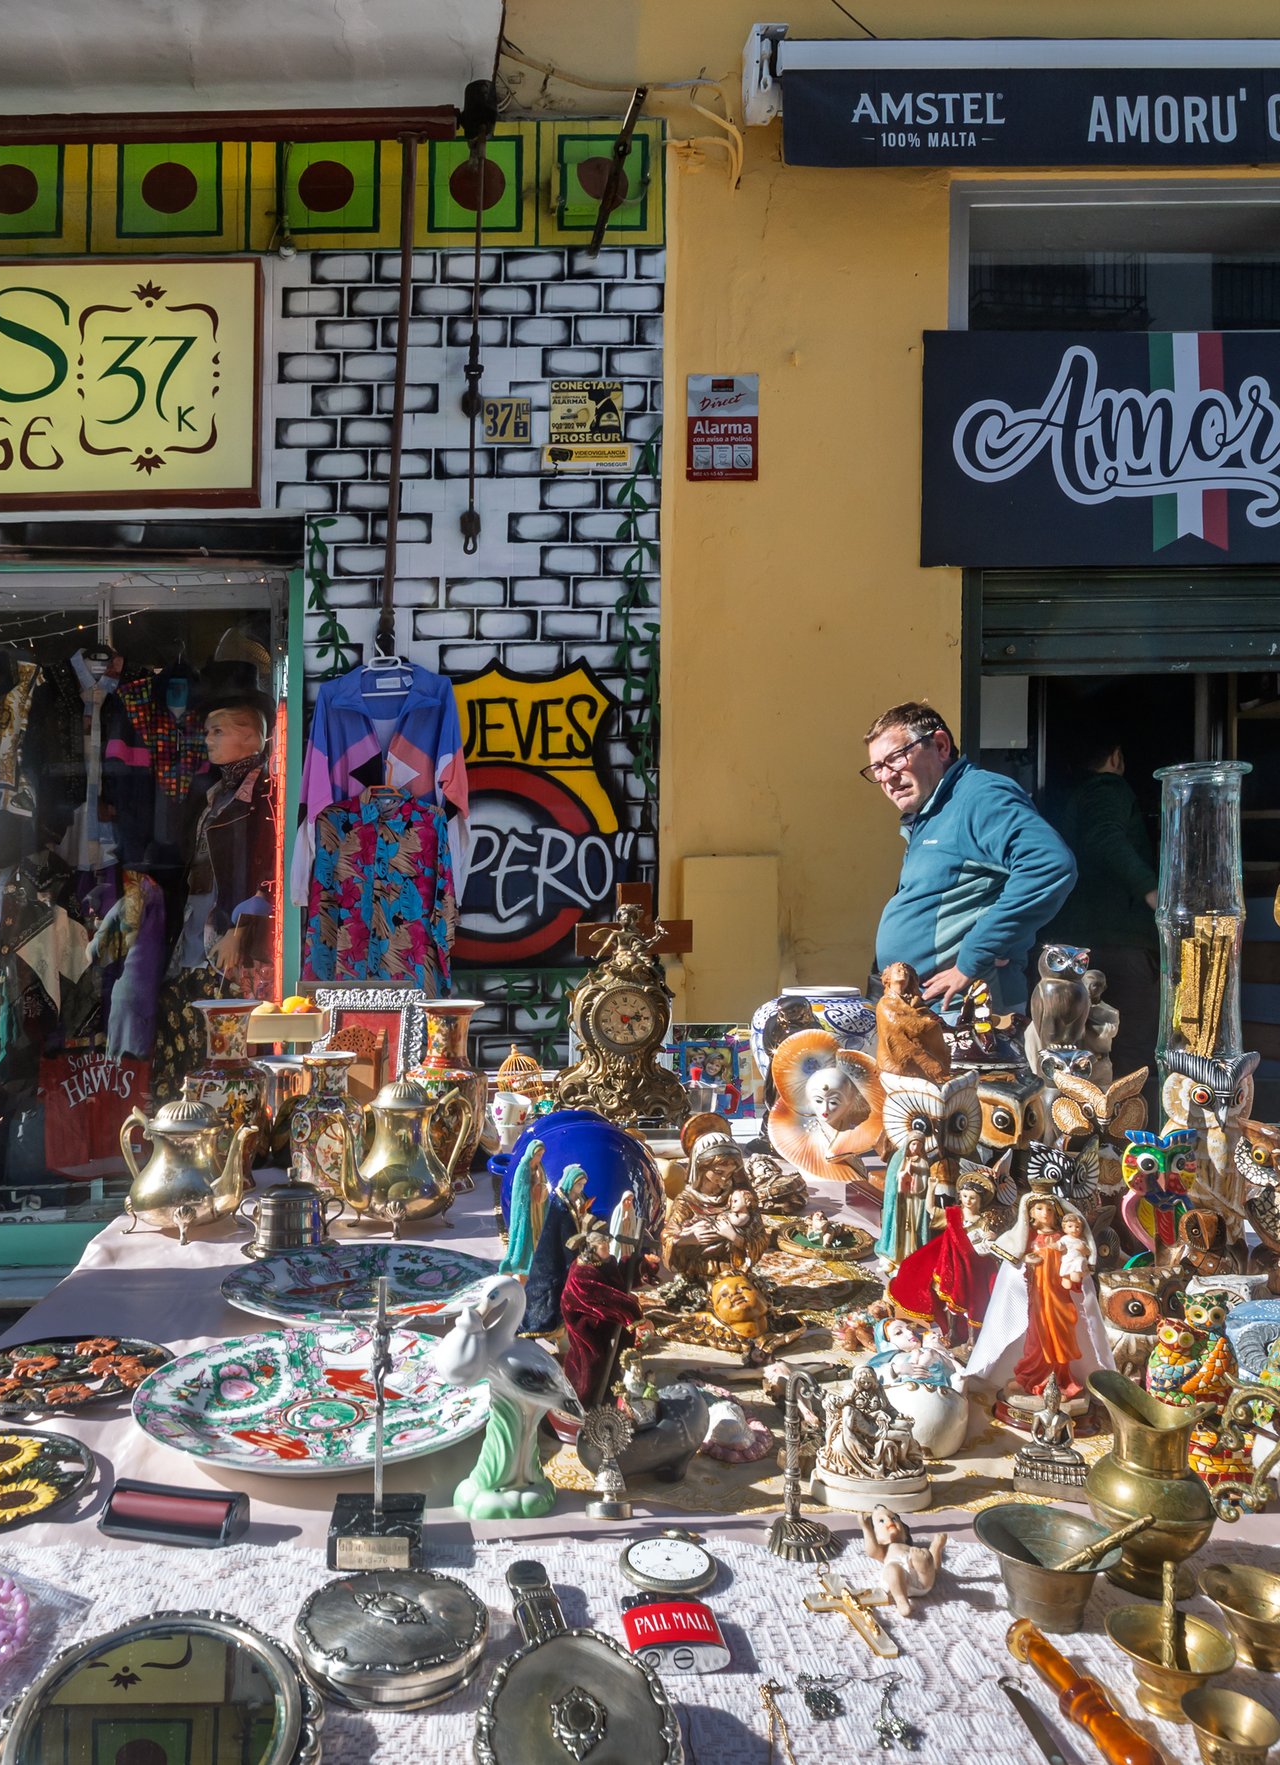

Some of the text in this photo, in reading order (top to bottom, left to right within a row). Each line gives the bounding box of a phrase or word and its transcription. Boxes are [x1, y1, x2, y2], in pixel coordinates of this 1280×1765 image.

[851, 92, 1006, 125] AMSTEL
[880, 131, 977, 148] 100% MALTA
[96, 335, 198, 425] 37
[551, 381, 622, 391] CONECTADA
[699, 393, 747, 412] Direct
[485, 402, 514, 438] 37
[693, 420, 753, 434] Alarma
[551, 433, 622, 443] PROSEGUR
[634, 1611, 714, 1636] PALL MALL
